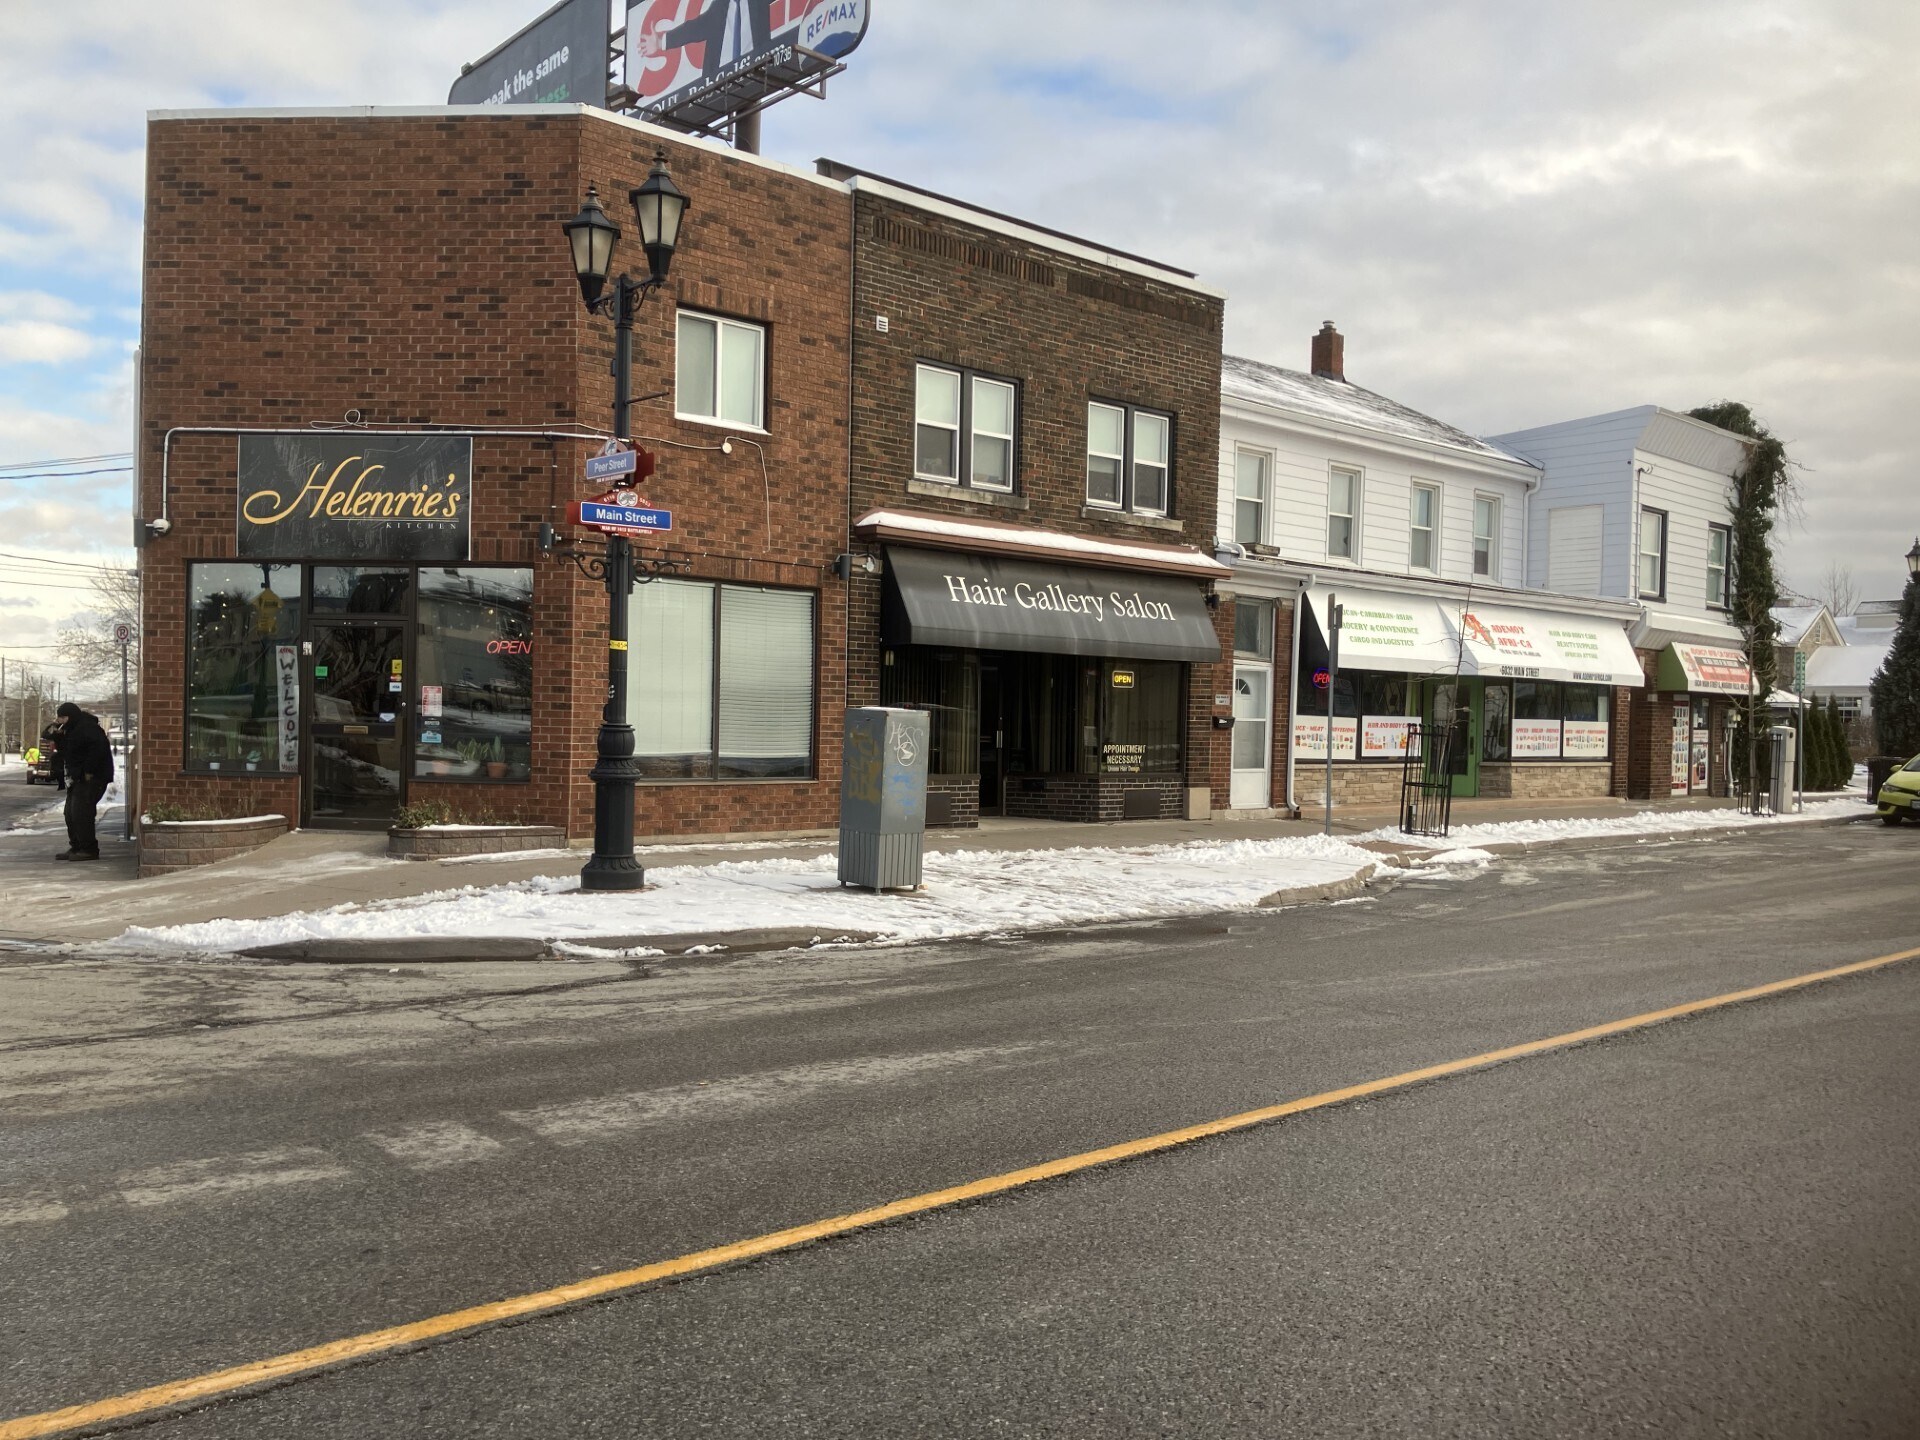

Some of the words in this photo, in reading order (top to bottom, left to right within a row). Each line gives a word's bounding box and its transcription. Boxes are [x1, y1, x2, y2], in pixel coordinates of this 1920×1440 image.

[806, 3, 857, 42] RE/MAX
[512, 69, 534, 95] the
[535, 45, 569, 80] same
[594, 462, 609, 473] Peer
[608, 457, 627, 470] Street
[242, 456, 461, 525] Helenrie's
[596, 508, 622, 521] Main
[624, 511, 657, 525] Street
[386, 522, 457, 530] KITCHEN
[943, 575, 1008, 607] Hair
[1014, 582, 1104, 622] Gallery
[1110, 592, 1176, 621] Salon
[1342, 622, 1367, 631] ROCERY
[486, 640, 533, 654] OPEN
[1383, 637, 1415, 647] LOGISTICS
[1114, 675, 1132, 683] OPEN
[1103, 744, 1147, 754] APPOINTMENT
[1106, 755, 1142, 765] NECESSARY
